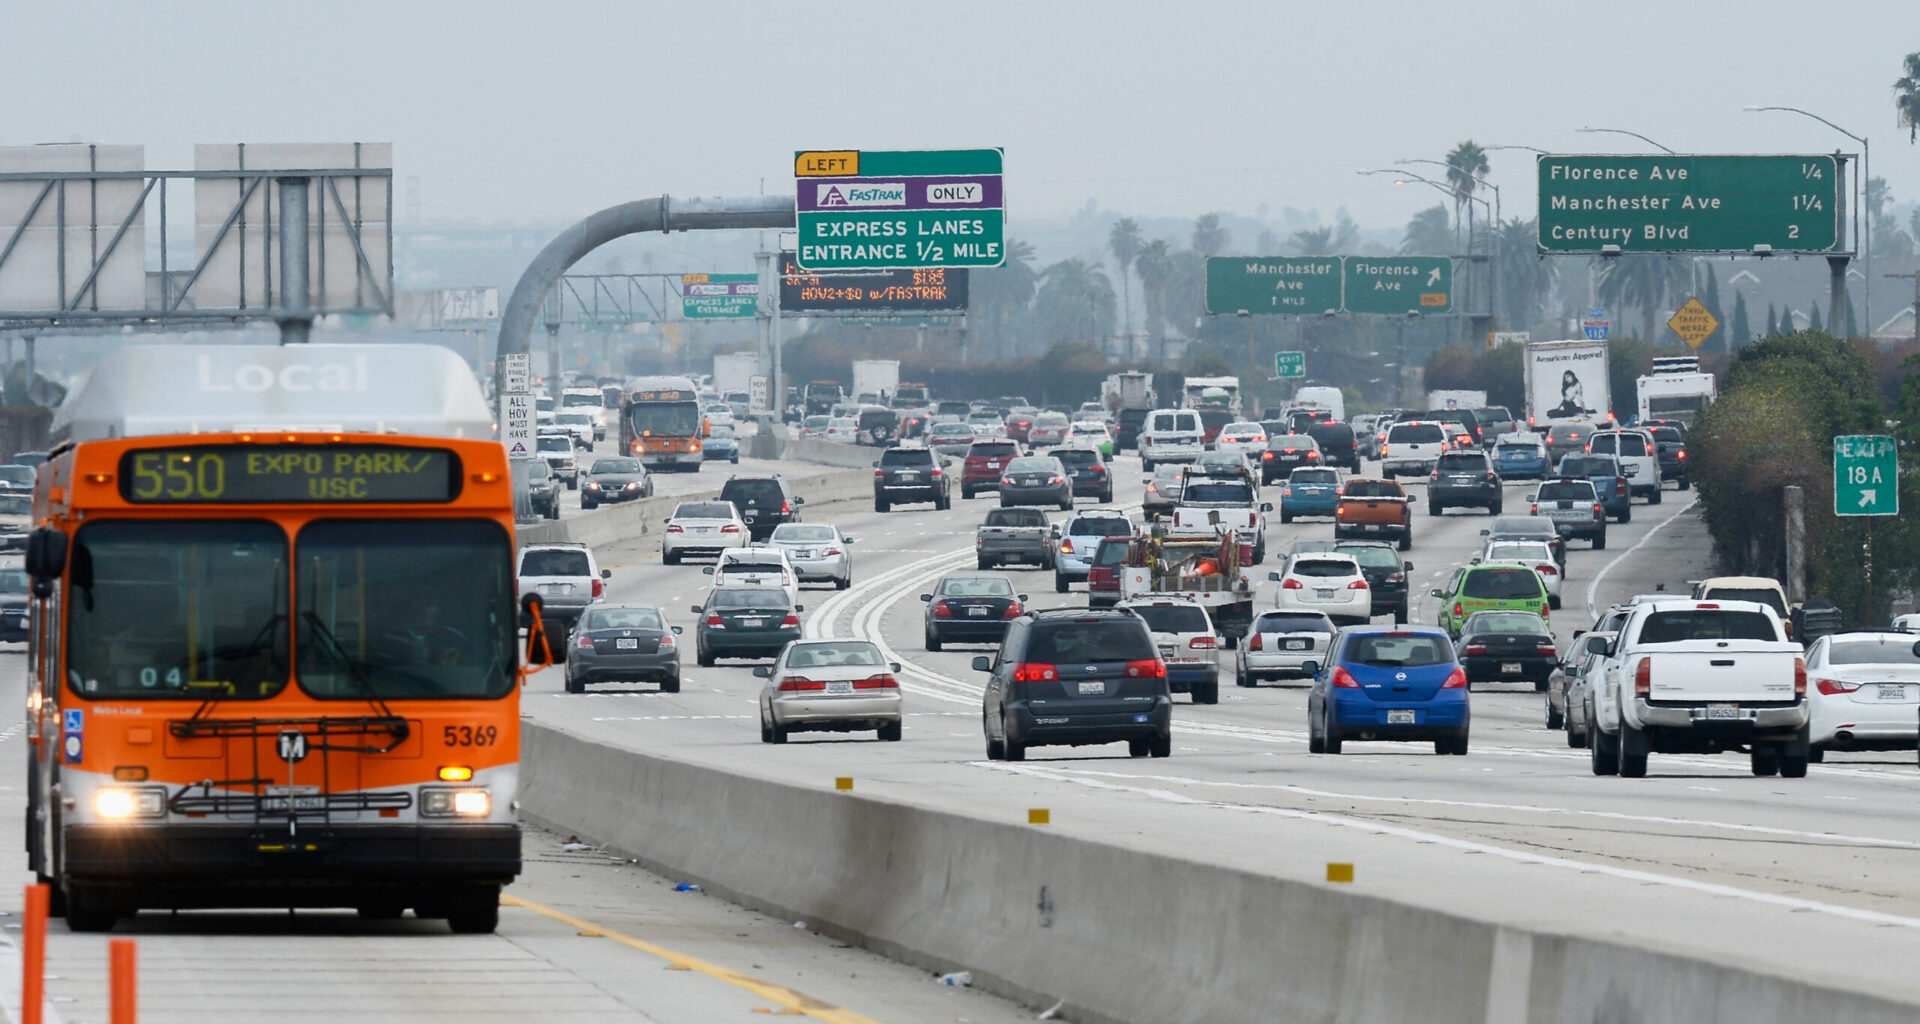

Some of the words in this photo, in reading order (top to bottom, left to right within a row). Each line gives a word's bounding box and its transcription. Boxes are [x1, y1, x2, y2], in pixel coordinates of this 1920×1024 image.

[807, 158, 847, 171] LEFT
[1551, 165, 1638, 180] Florence
[1650, 166, 1688, 180] Ave
[933, 186, 975, 200] ONLY
[1551, 195, 1669, 210] Manchester
[1682, 197, 1721, 210] Ave
[816, 221, 907, 237] EXPRESS
[918, 220, 984, 236] LANES
[1552, 226, 1632, 245] Century
[1644, 226, 1688, 240] Blvd
[1788, 226, 1799, 239] 2
[803, 244, 906, 261] ENTRANCE
[954, 242, 999, 258] MILE
[1246, 263, 1331, 275] Manchester
[1356, 263, 1419, 276] Florence
[1276, 280, 1303, 290] Ave
[1374, 280, 1400, 291] Ave
[1272, 296, 1277, 305] 1
[1283, 297, 1305, 305] MILE
[1678, 316, 1709, 324] TRAFFIC
[1588, 329, 1605, 339] 110
[1536, 353, 1571, 363] American
[1572, 351, 1603, 361] Apparel
[199, 352, 369, 392] Local
[509, 397, 527, 407] ALL
[509, 409, 527, 419] HOV
[509, 420, 528, 428] MUST
[509, 430, 528, 439] HAVE
[1843, 442, 1886, 458] EXIT
[135, 453, 225, 498] 550
[247, 453, 322, 474] EXPO
[334, 453, 432, 474] PARK/
[309, 477, 367, 499] USC
[119, 706, 143, 715] Local
[444, 725, 498, 747] 5369
